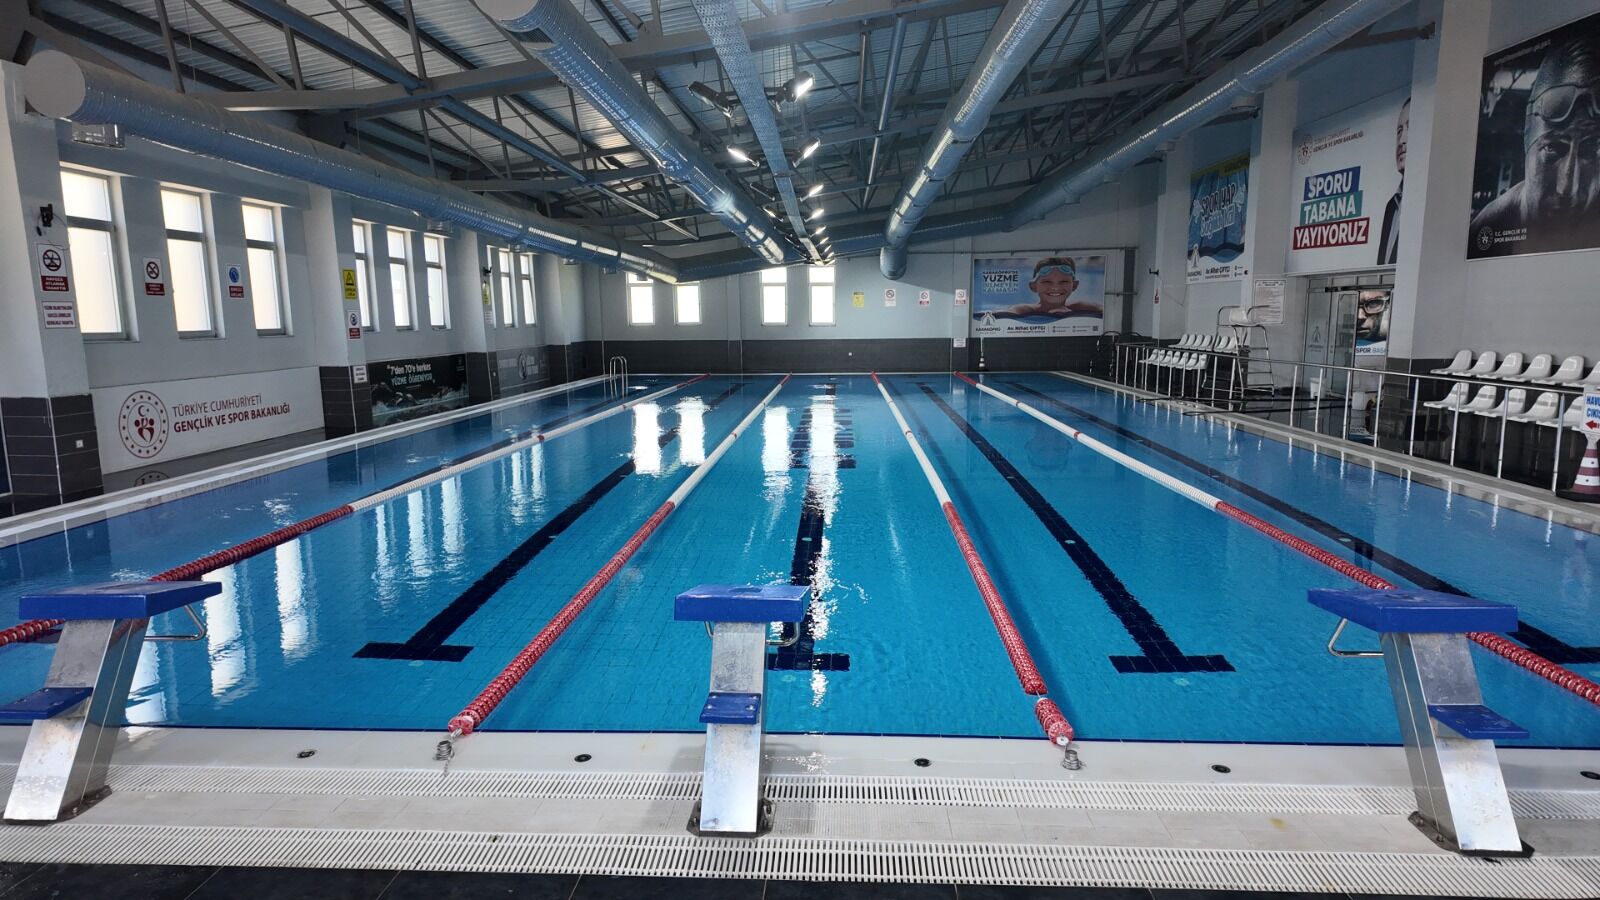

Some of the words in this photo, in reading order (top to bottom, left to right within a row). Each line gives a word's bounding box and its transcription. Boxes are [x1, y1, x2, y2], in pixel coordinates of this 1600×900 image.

[1307, 171, 1353, 199] SPORU
[1303, 194, 1356, 225] TABANA
[1295, 220, 1367, 248] YAYIYORUZ
[983, 274, 1019, 282] YÜZME
[172, 401, 208, 418] TÜRKİYE
[210, 393, 262, 412] CUMHURİYETİ
[174, 415, 214, 433] GENÇLİK
[214, 415, 227, 426] VE
[228, 410, 250, 424] SPOR
[251, 402, 290, 420] BAKANLIĞI
